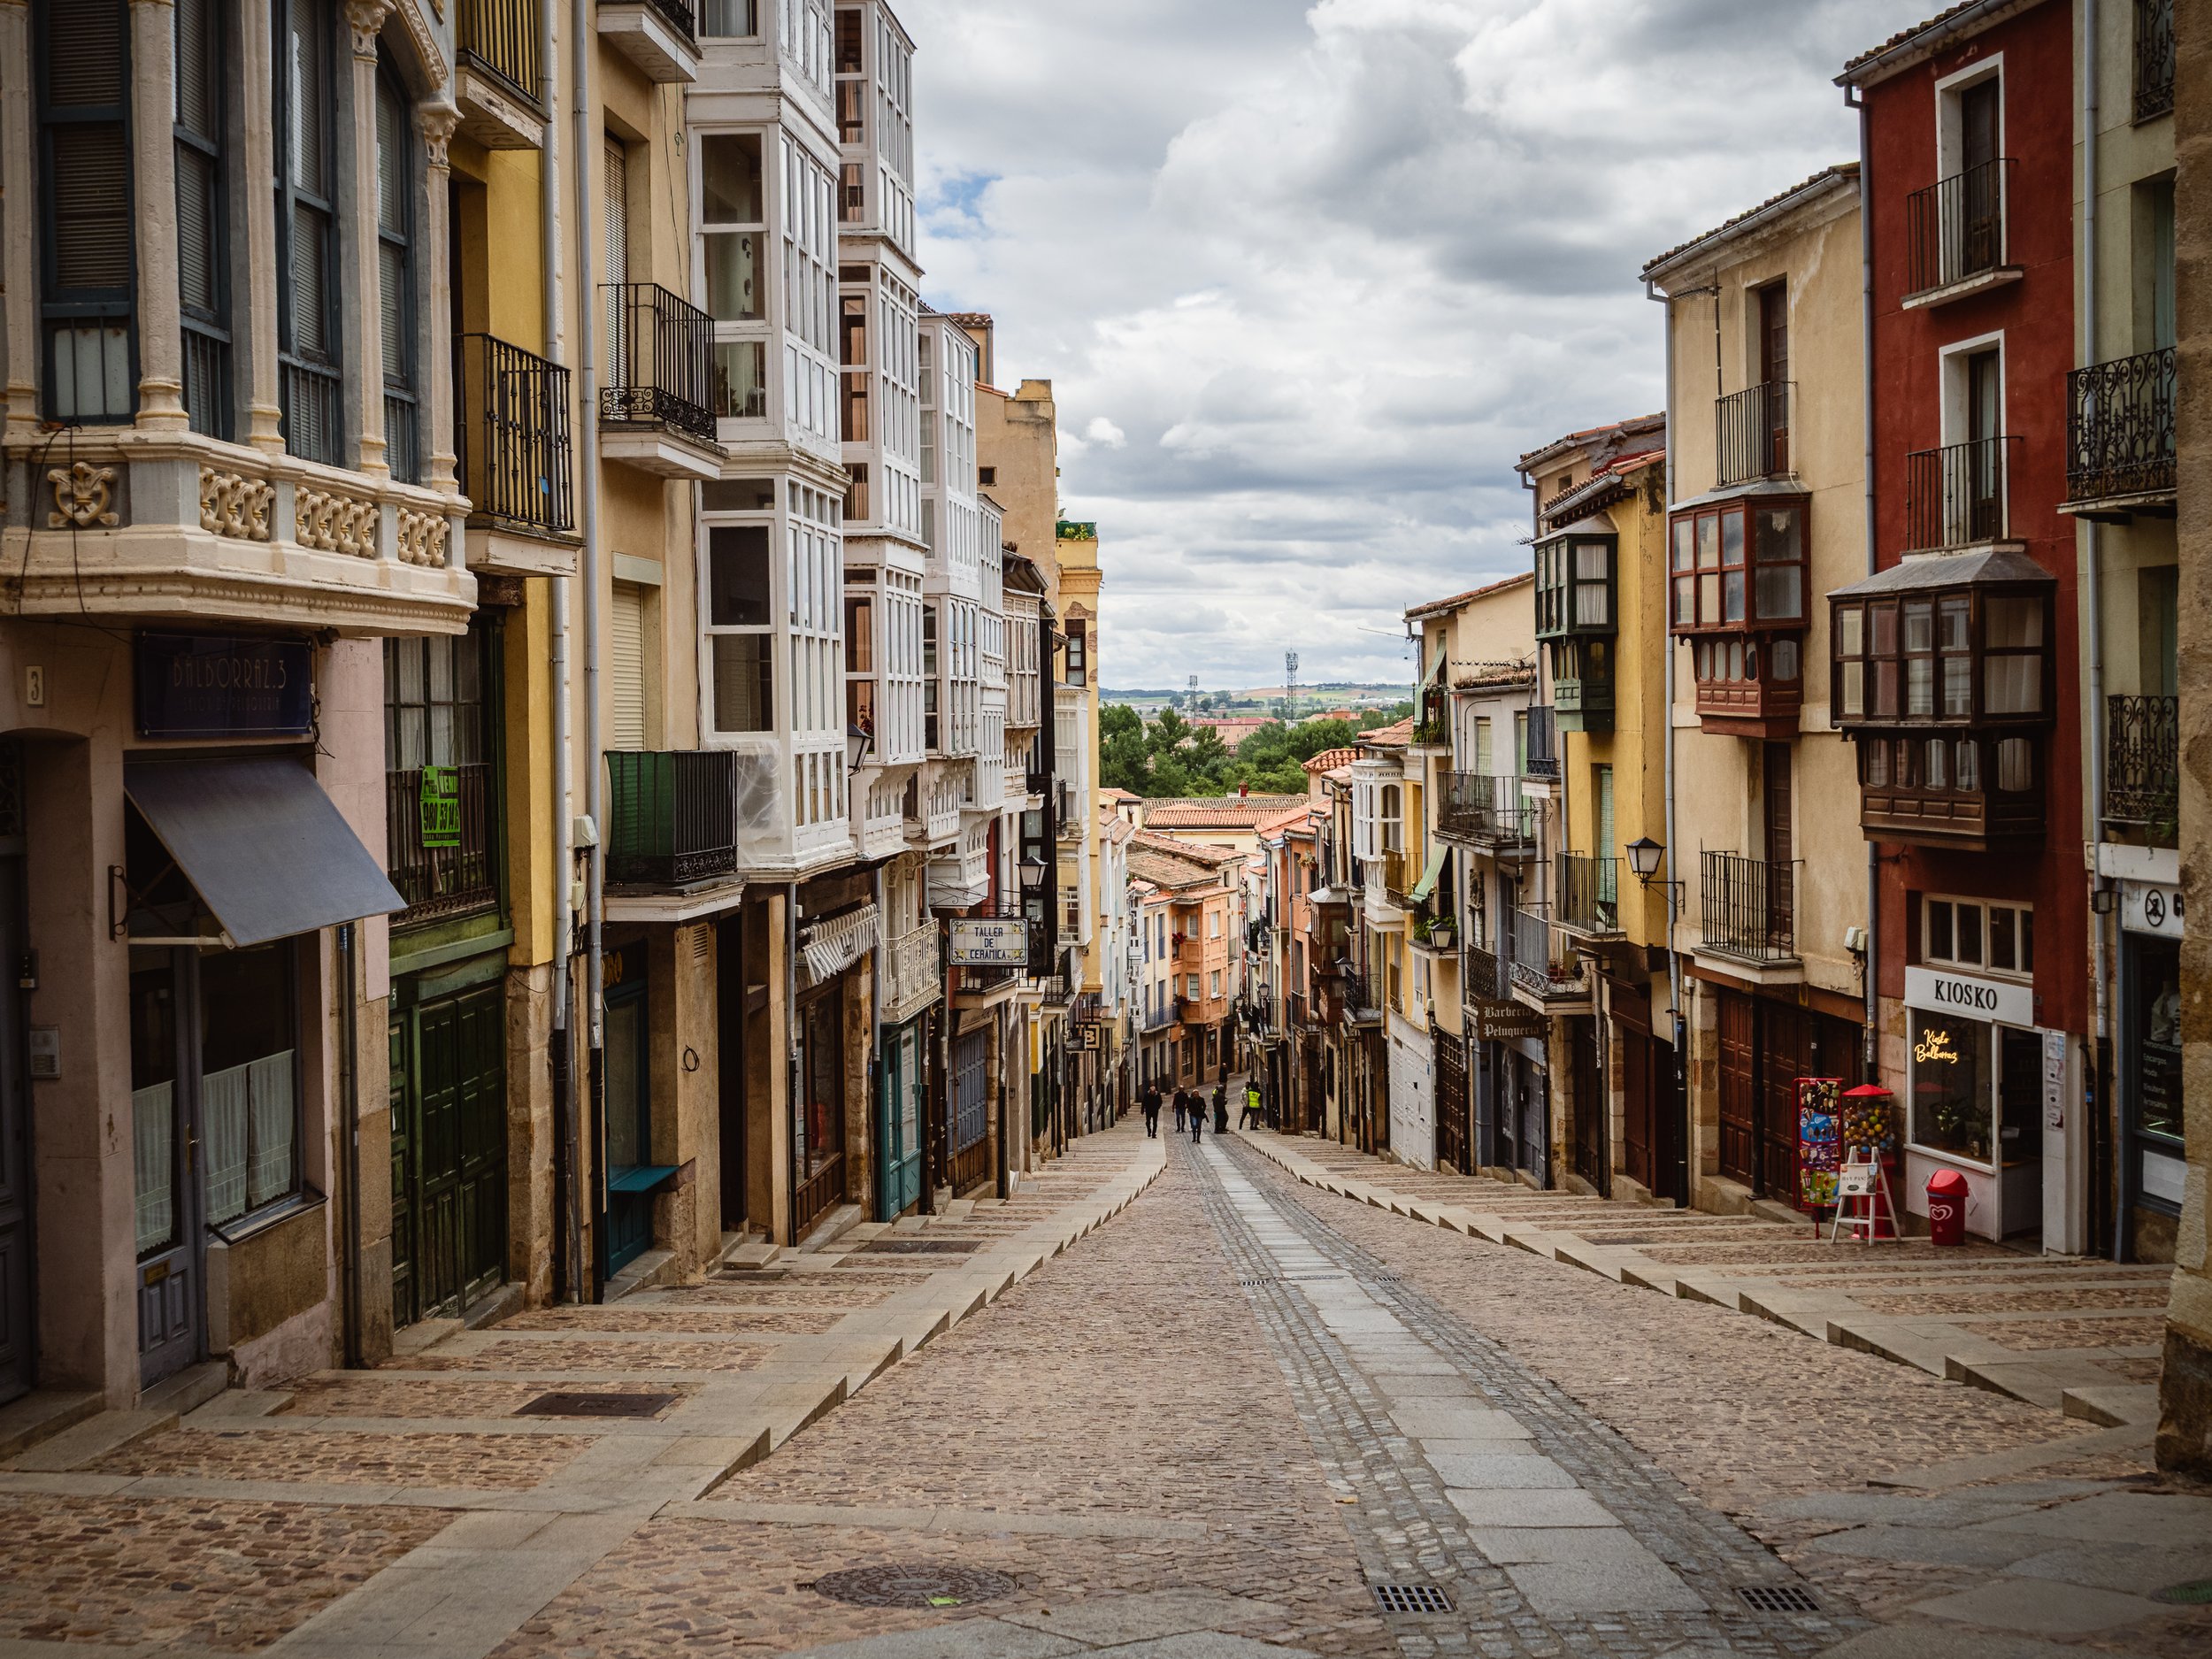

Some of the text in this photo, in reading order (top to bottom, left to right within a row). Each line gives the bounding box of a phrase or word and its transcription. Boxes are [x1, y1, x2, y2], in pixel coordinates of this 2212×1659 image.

[31, 671, 39, 701] 3
[423, 802, 437, 831] 980
[974, 926, 1003, 937] TALLER
[984, 938, 994, 948] DE
[392, 988, 396, 1001] 5
[1934, 979, 1998, 1010] KIOSKO
[1924, 1028, 1950, 1048] Kiosko
